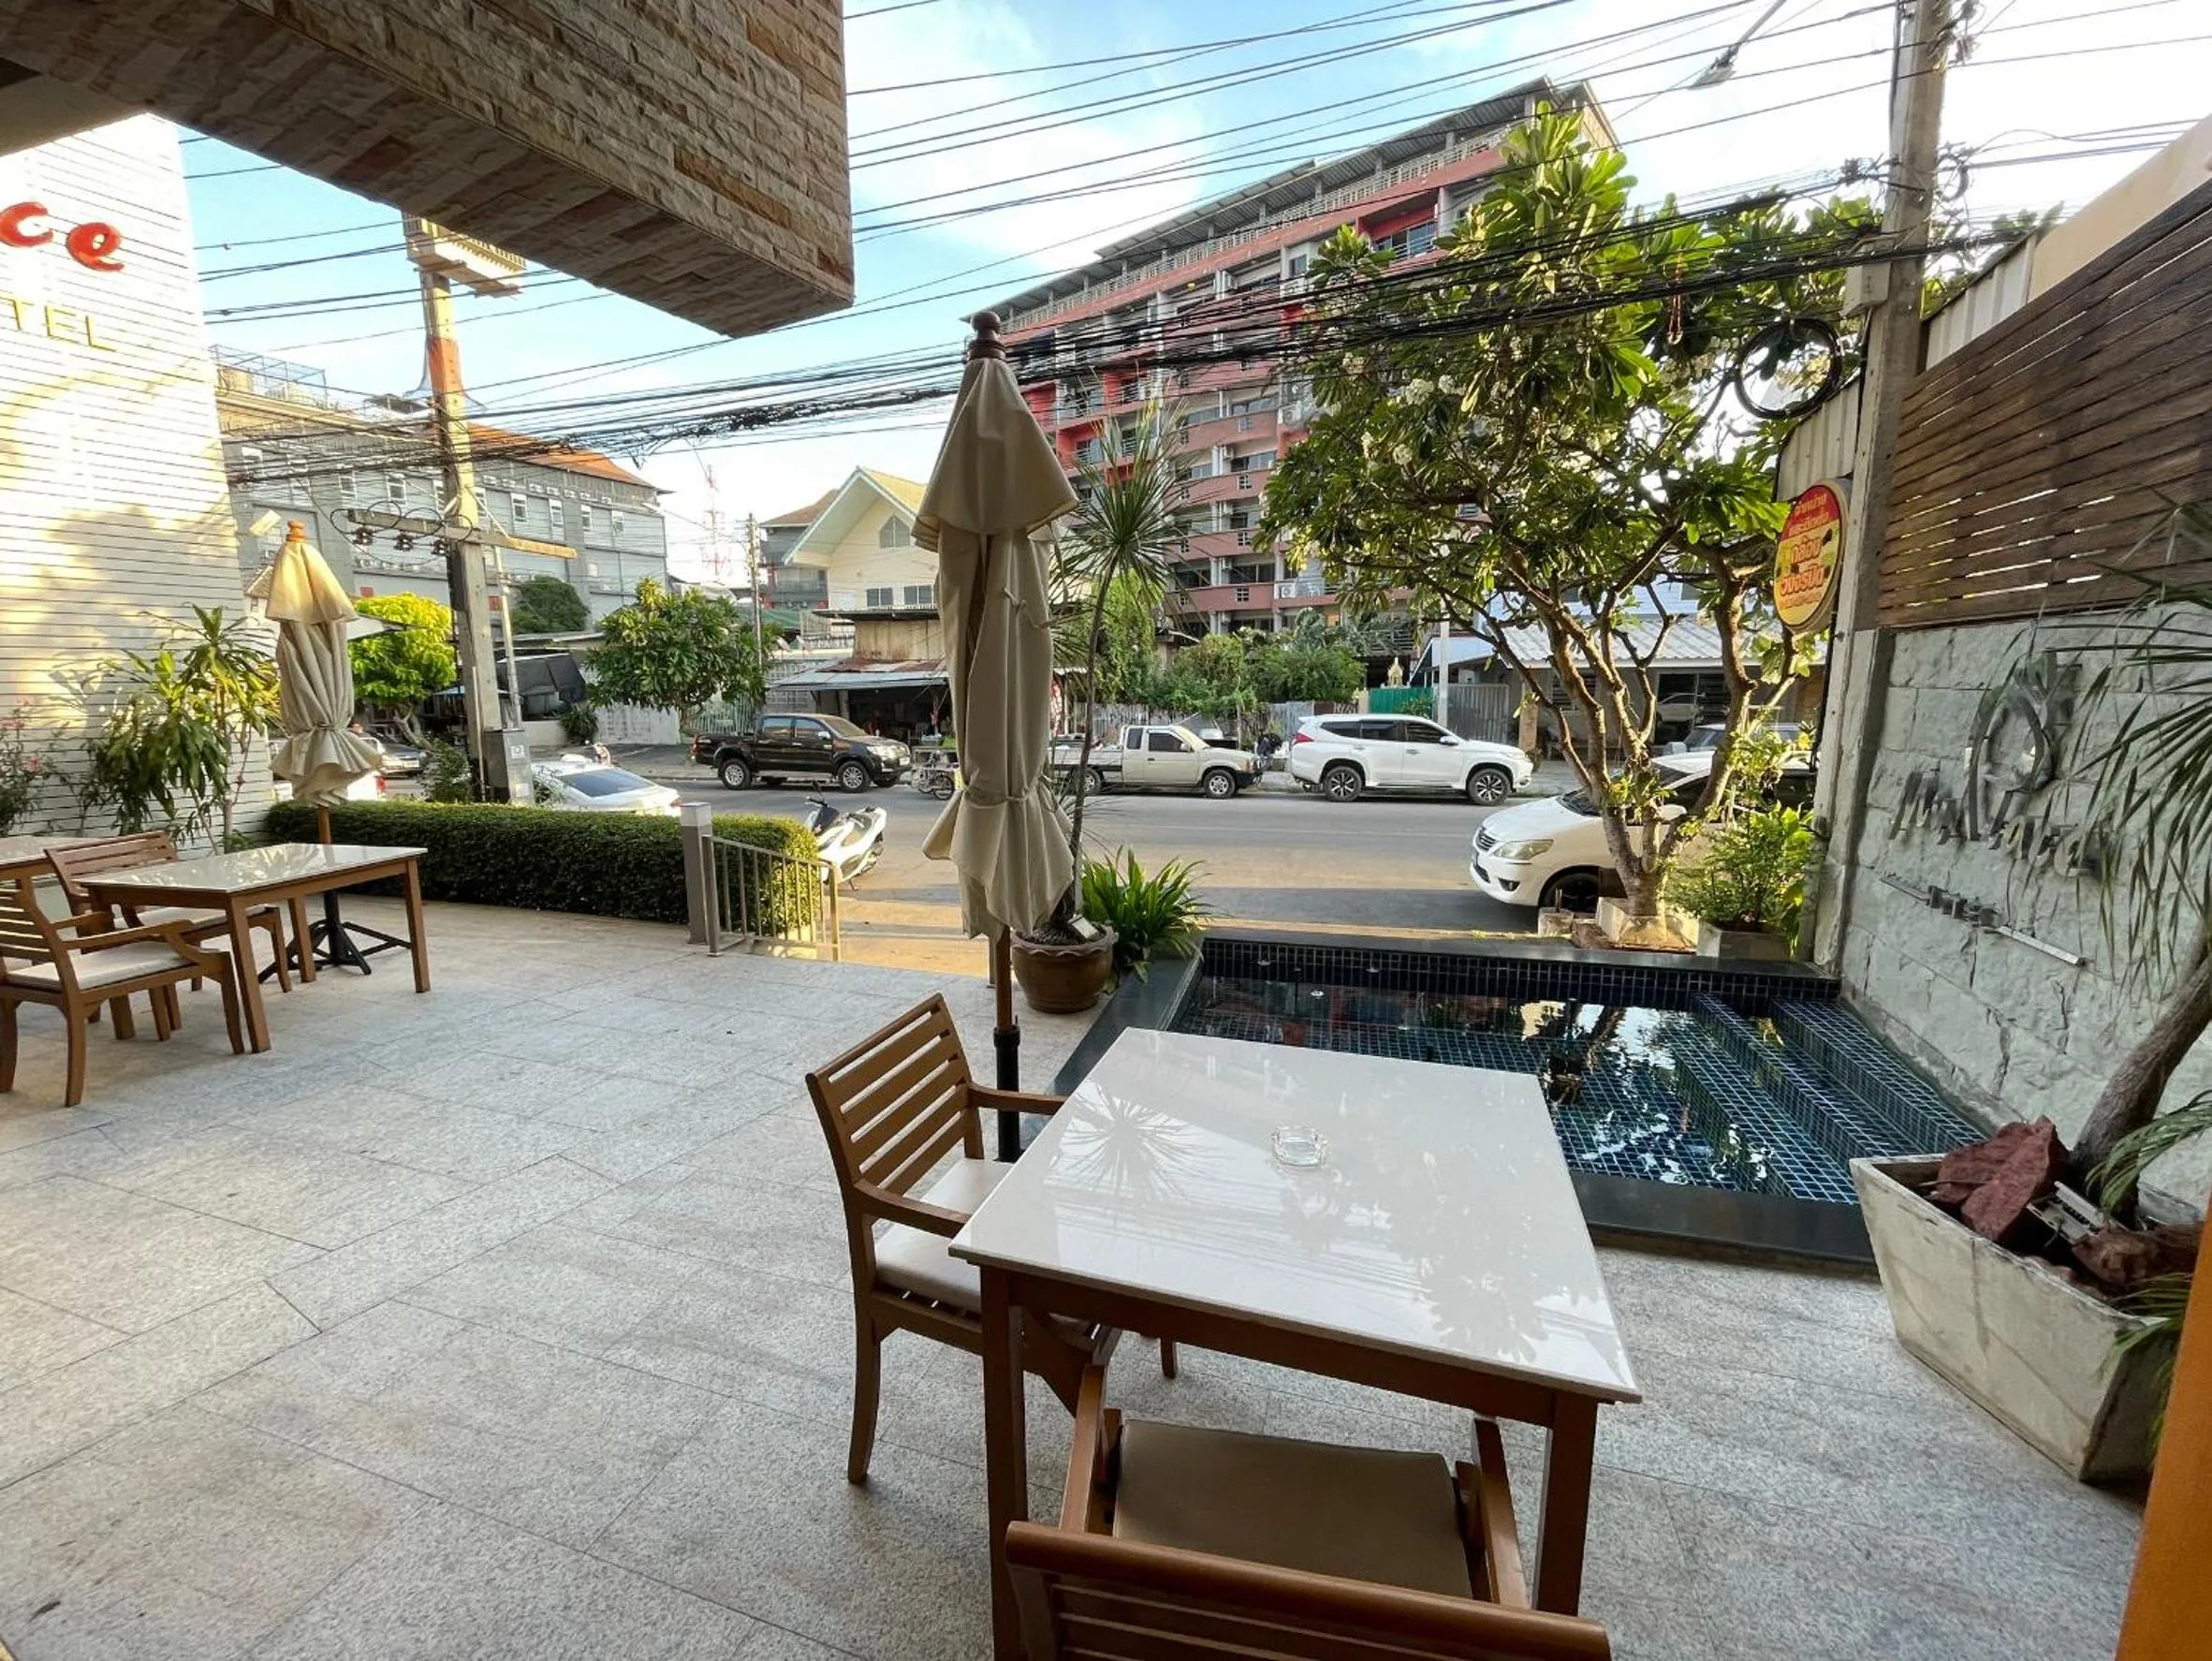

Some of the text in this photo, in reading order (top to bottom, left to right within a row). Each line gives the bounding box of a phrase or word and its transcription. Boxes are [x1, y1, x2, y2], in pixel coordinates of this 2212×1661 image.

[1792, 536, 1821, 563] กล้อง
[1780, 563, 1824, 596] วงจรปิด
